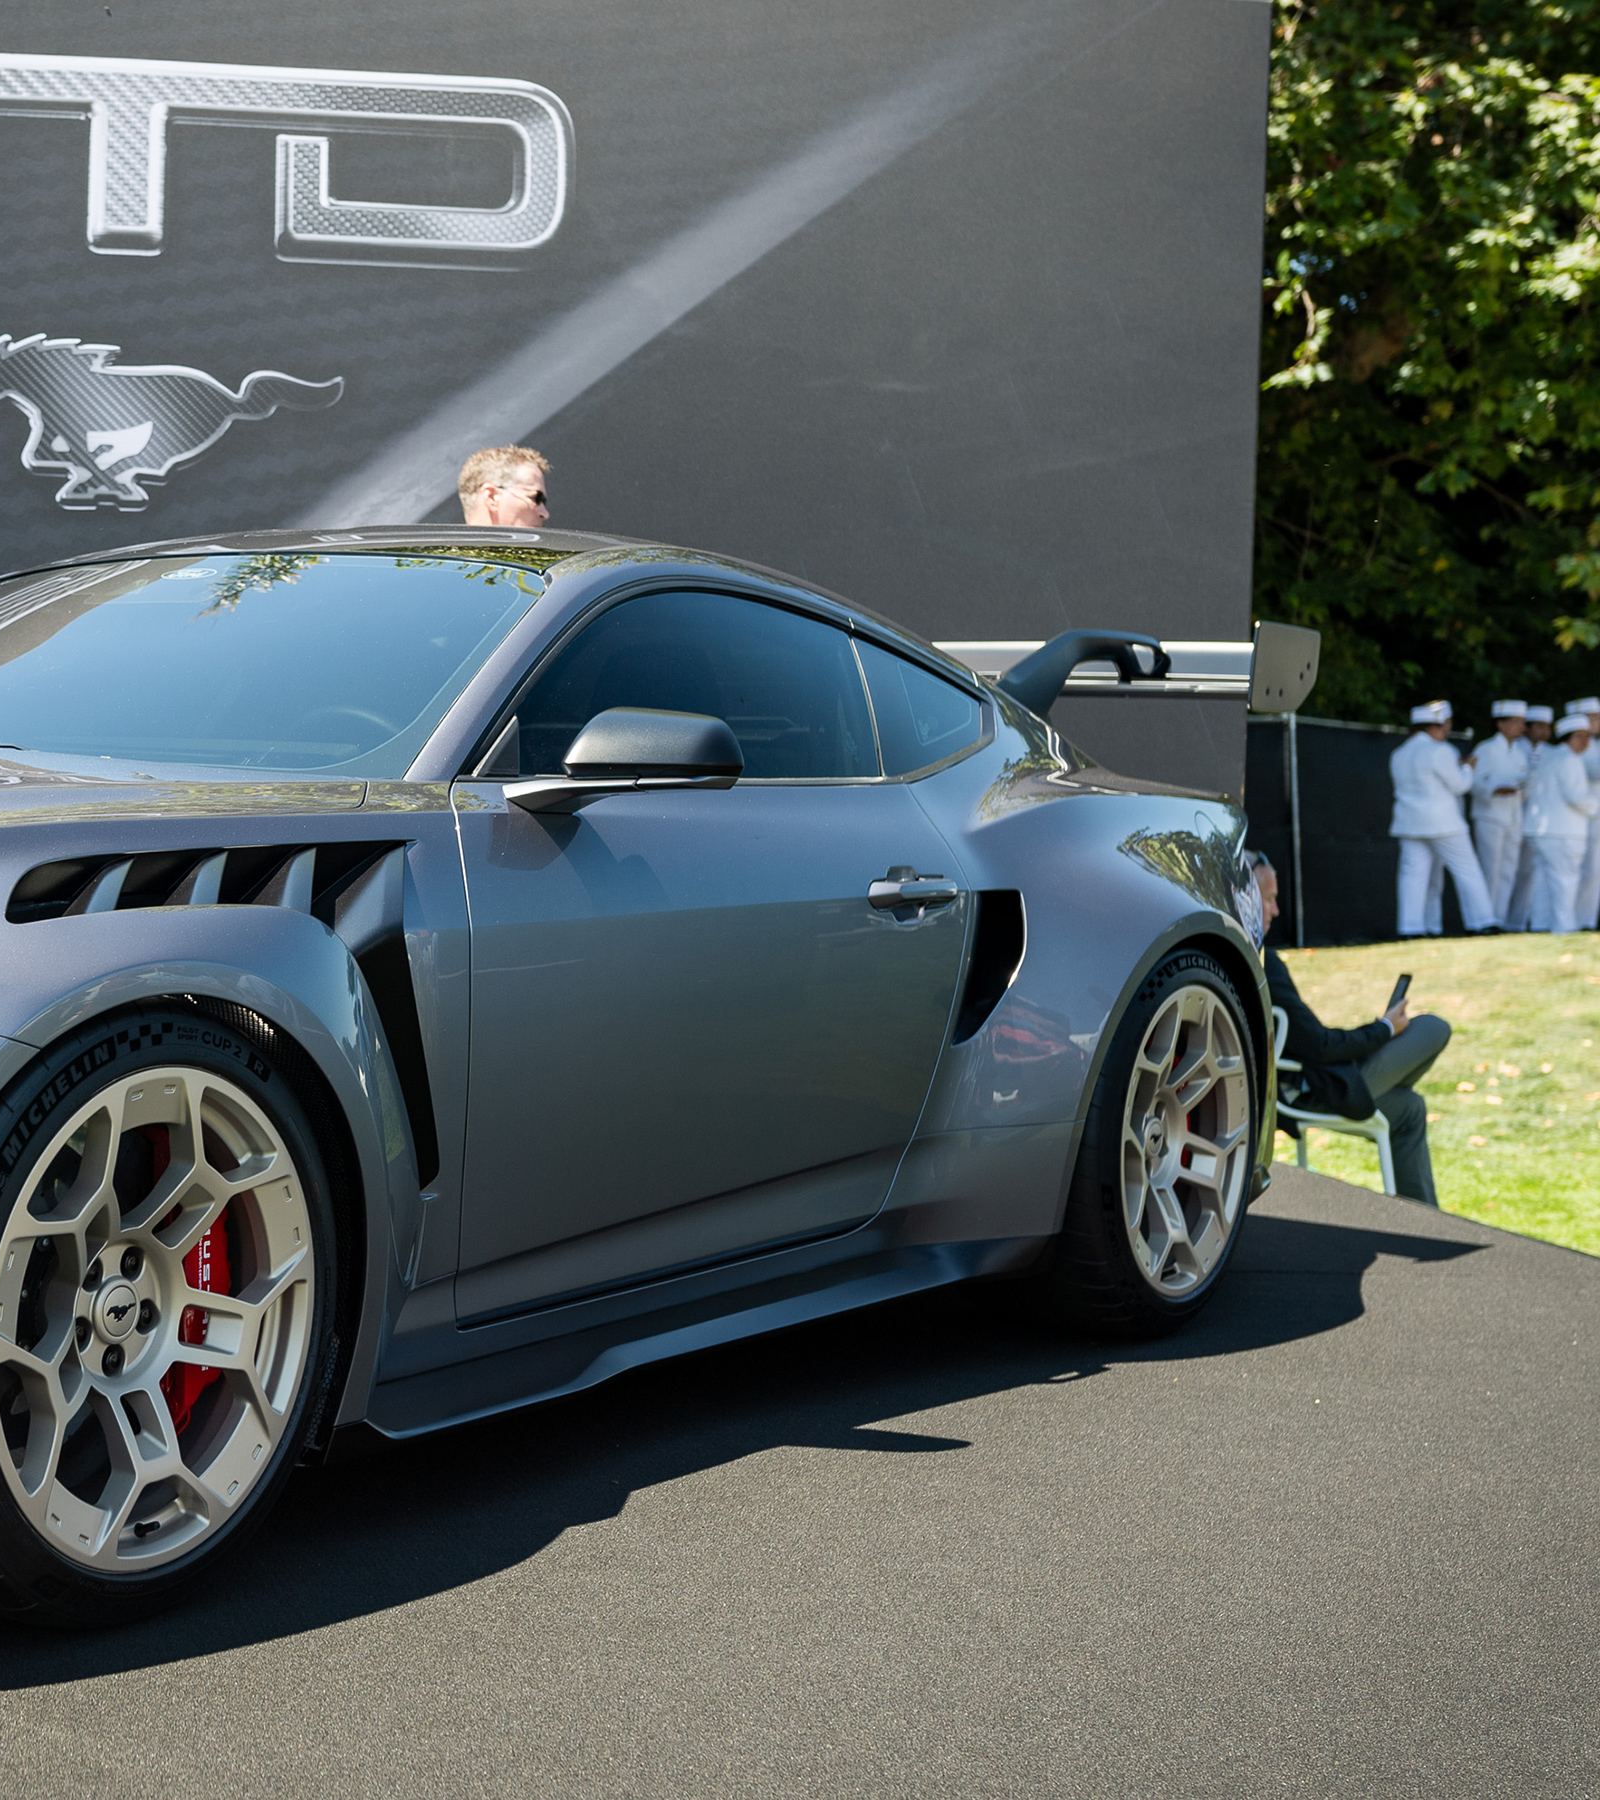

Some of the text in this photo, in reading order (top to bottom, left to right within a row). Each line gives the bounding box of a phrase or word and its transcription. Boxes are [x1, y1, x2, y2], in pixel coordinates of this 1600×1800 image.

[1179, 956, 1226, 979] MICHELIN
[177, 1026, 199, 1034] PILOT
[177, 1034, 199, 1042] SPORT
[201, 1031, 232, 1051] CUP
[233, 1045, 242, 1059] 2
[2, 1043, 111, 1167] MICHELIN
